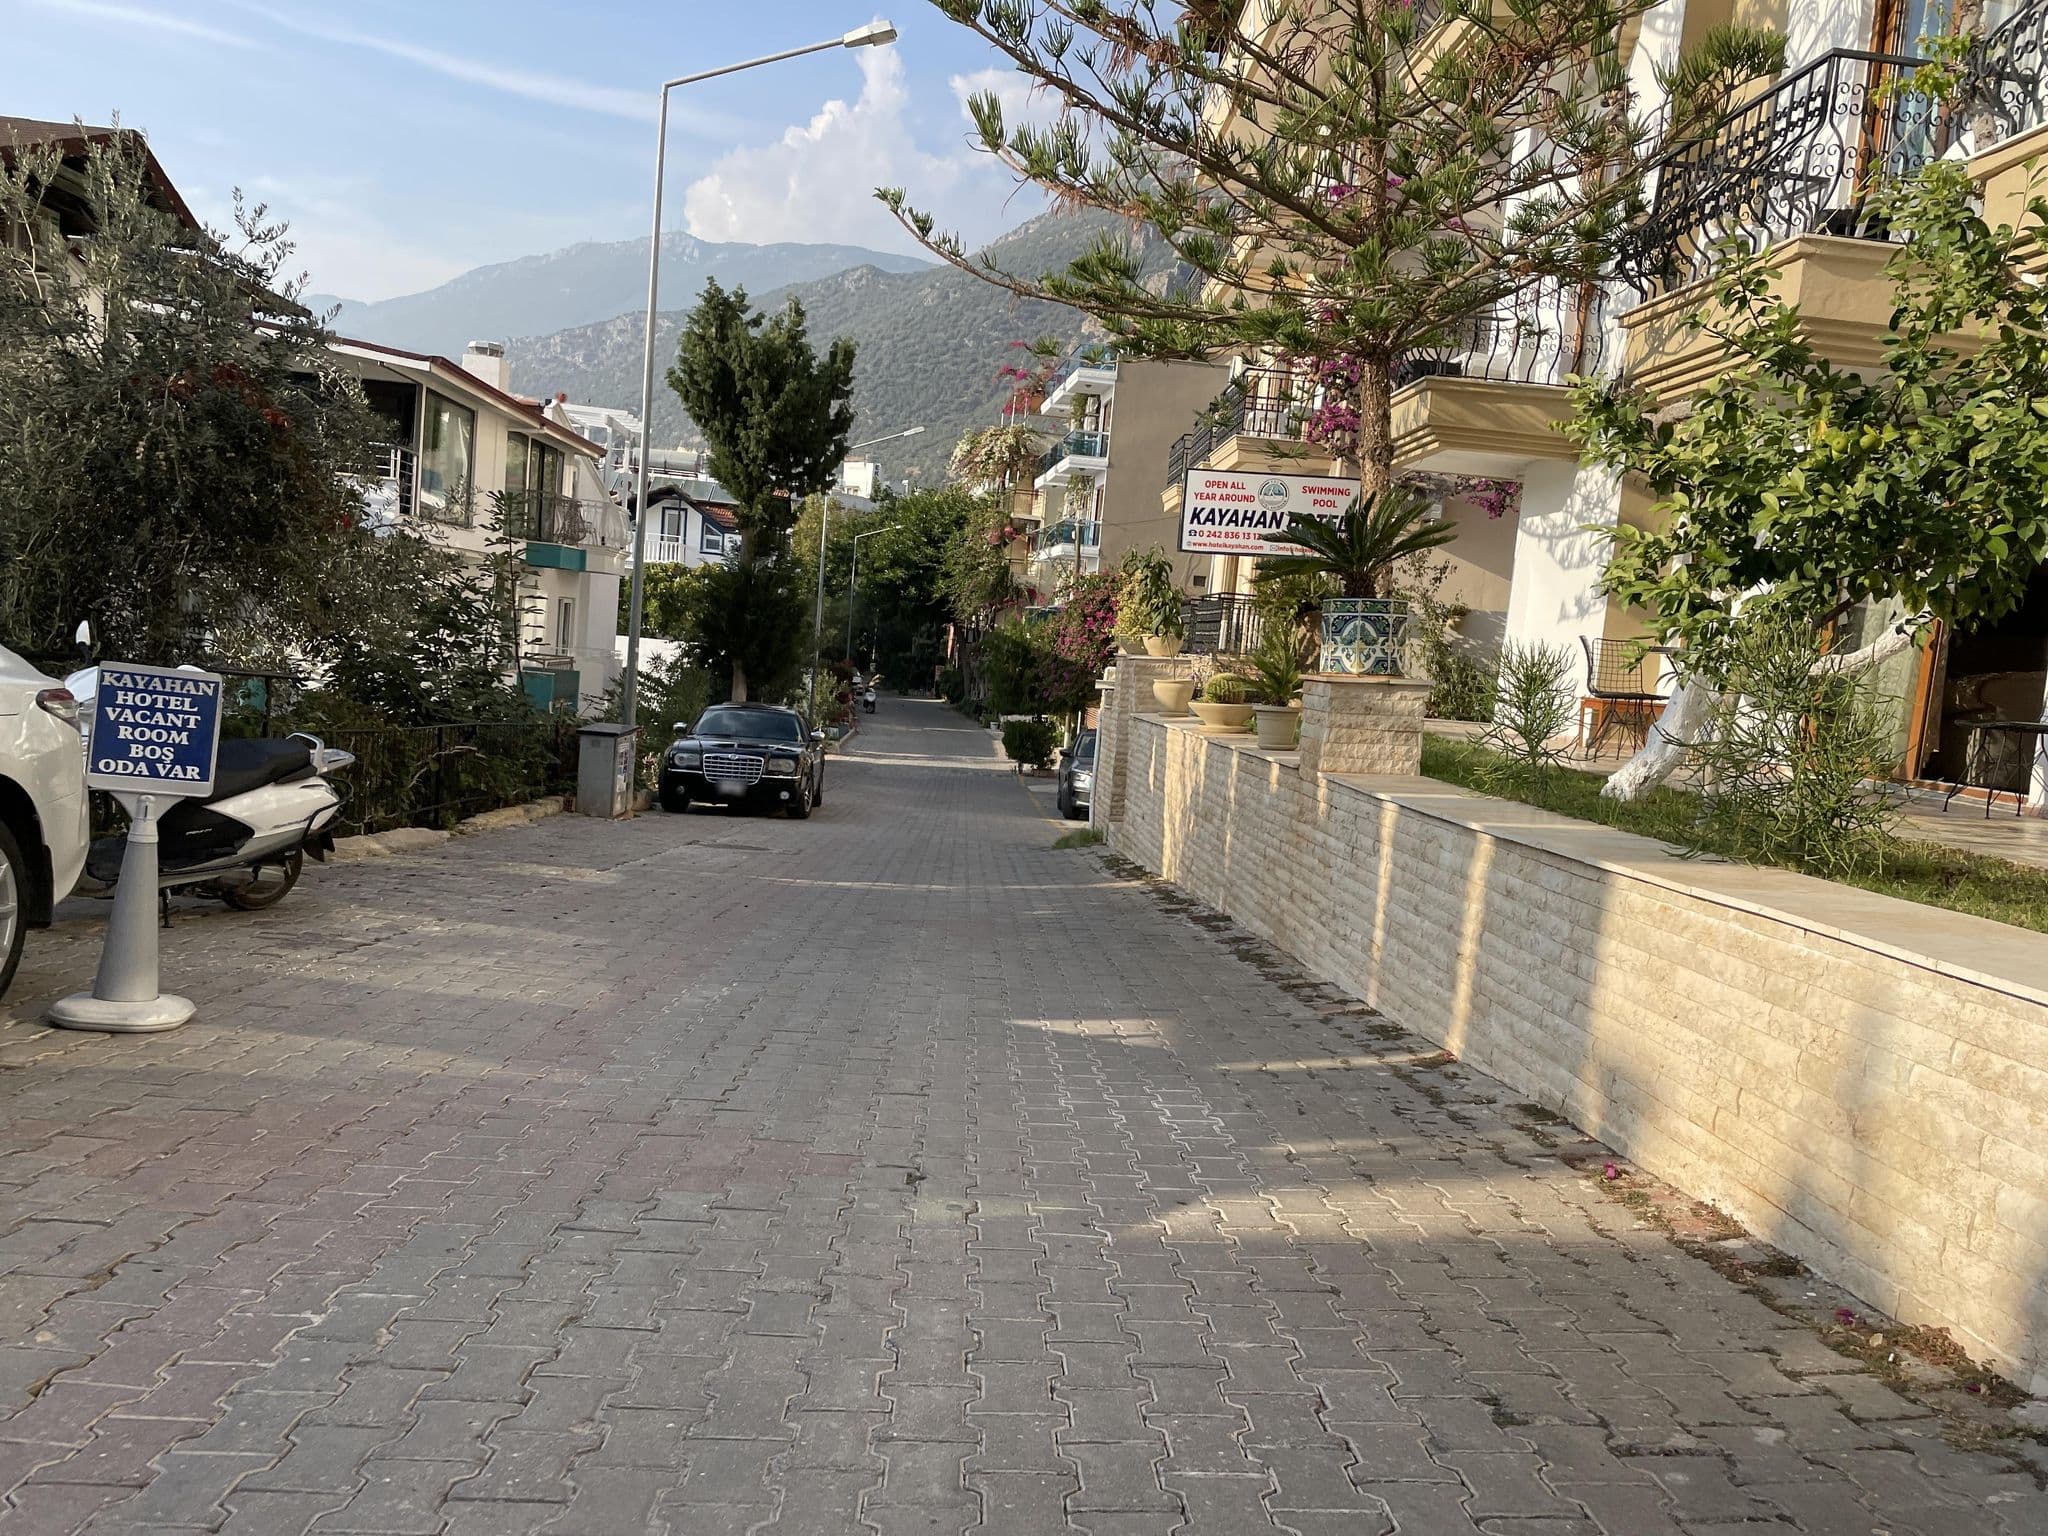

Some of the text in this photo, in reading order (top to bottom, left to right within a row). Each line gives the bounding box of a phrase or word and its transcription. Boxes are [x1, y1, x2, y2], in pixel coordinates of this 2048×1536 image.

[1205, 480, 1246, 490] OPEN ALL
[1302, 486, 1351, 496] SWIMMING
[1194, 492, 1256, 503] YEAR AROUND
[1313, 499, 1338, 509] POOL
[1190, 507, 1285, 529] KAYAHAN
[1198, 530, 1205, 538] 0
[1206, 530, 1223, 539] 242
[1224, 531, 1240, 540] 836
[1242, 532, 1251, 541] 13
[102, 672, 215, 696] KAYAHAN
[115, 690, 199, 712] HOTEL
[105, 706, 201, 729] VACANT
[117, 725, 190, 745] ROOM
[128, 743, 175, 764] BOŞ
[98, 758, 201, 780] ODA VAR
